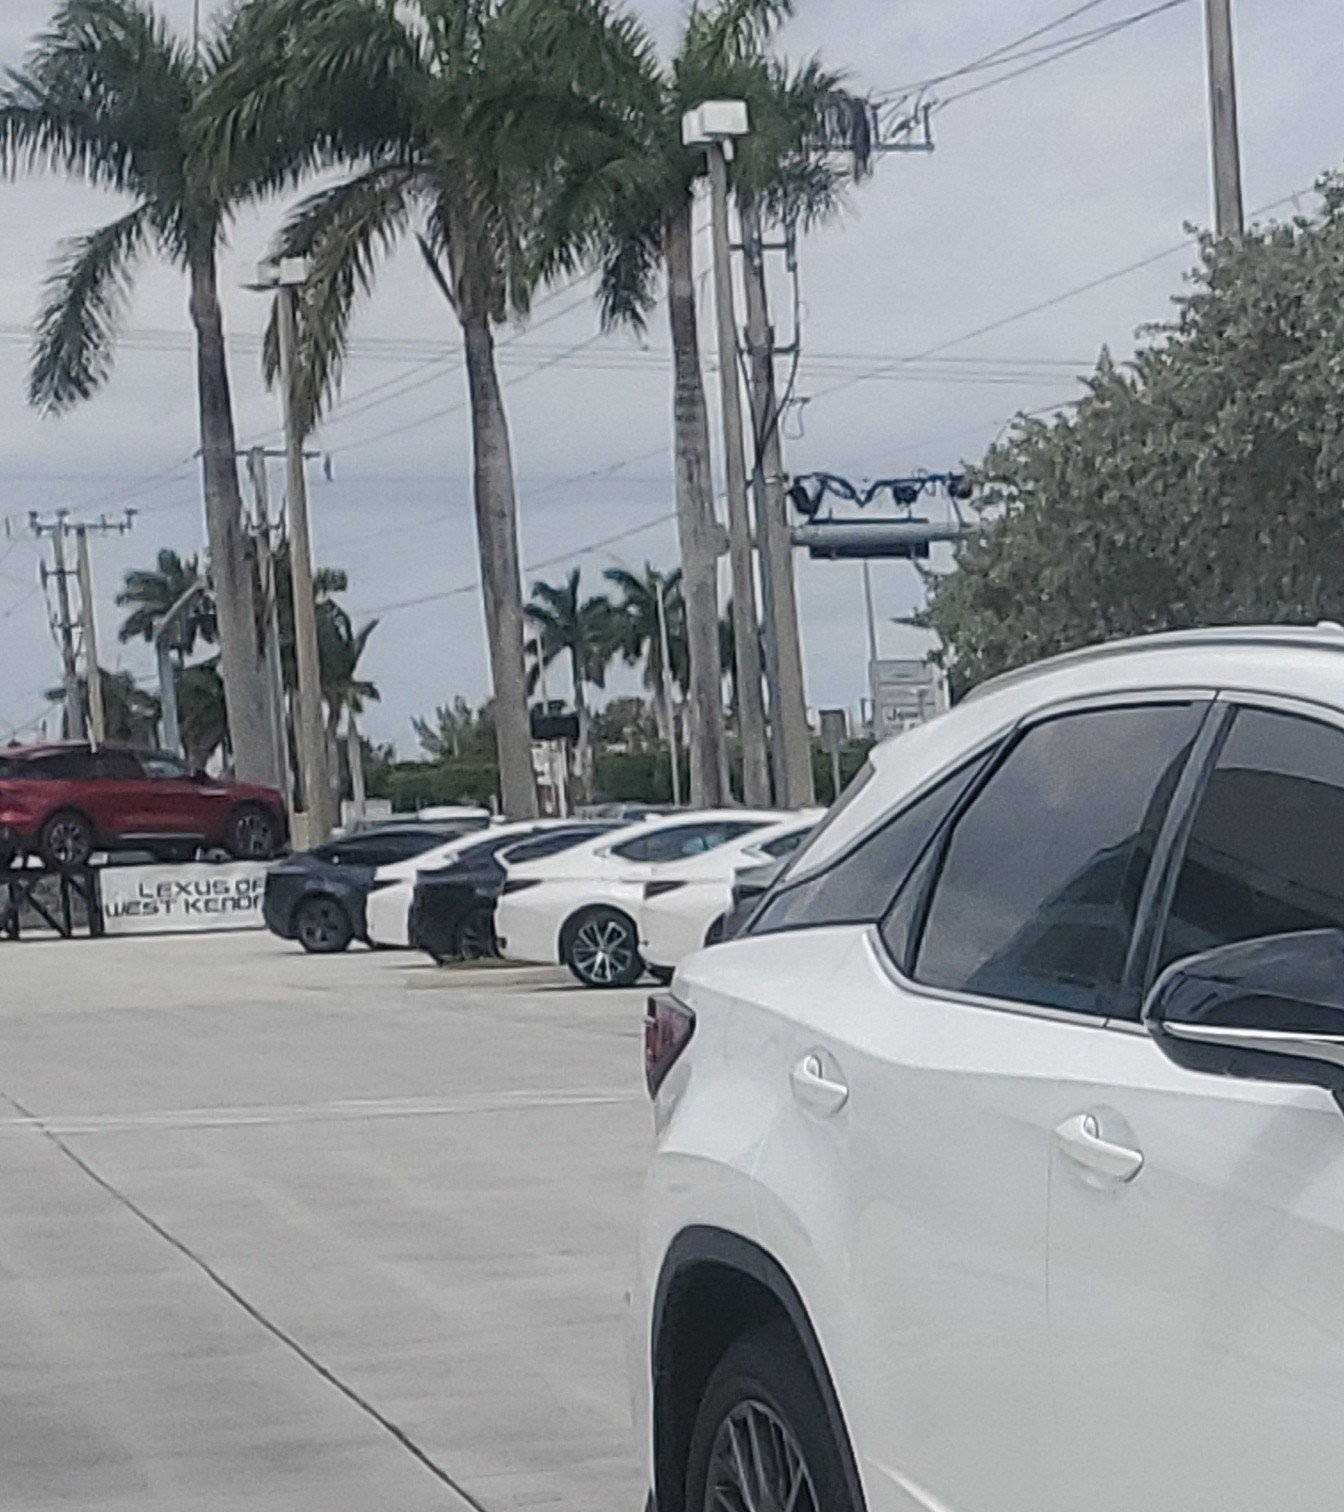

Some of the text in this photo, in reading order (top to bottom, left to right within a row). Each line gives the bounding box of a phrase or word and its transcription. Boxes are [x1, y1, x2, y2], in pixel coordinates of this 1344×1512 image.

[139, 877, 263, 898] LEXUS OF
[105, 895, 260, 917] WEST KEND
